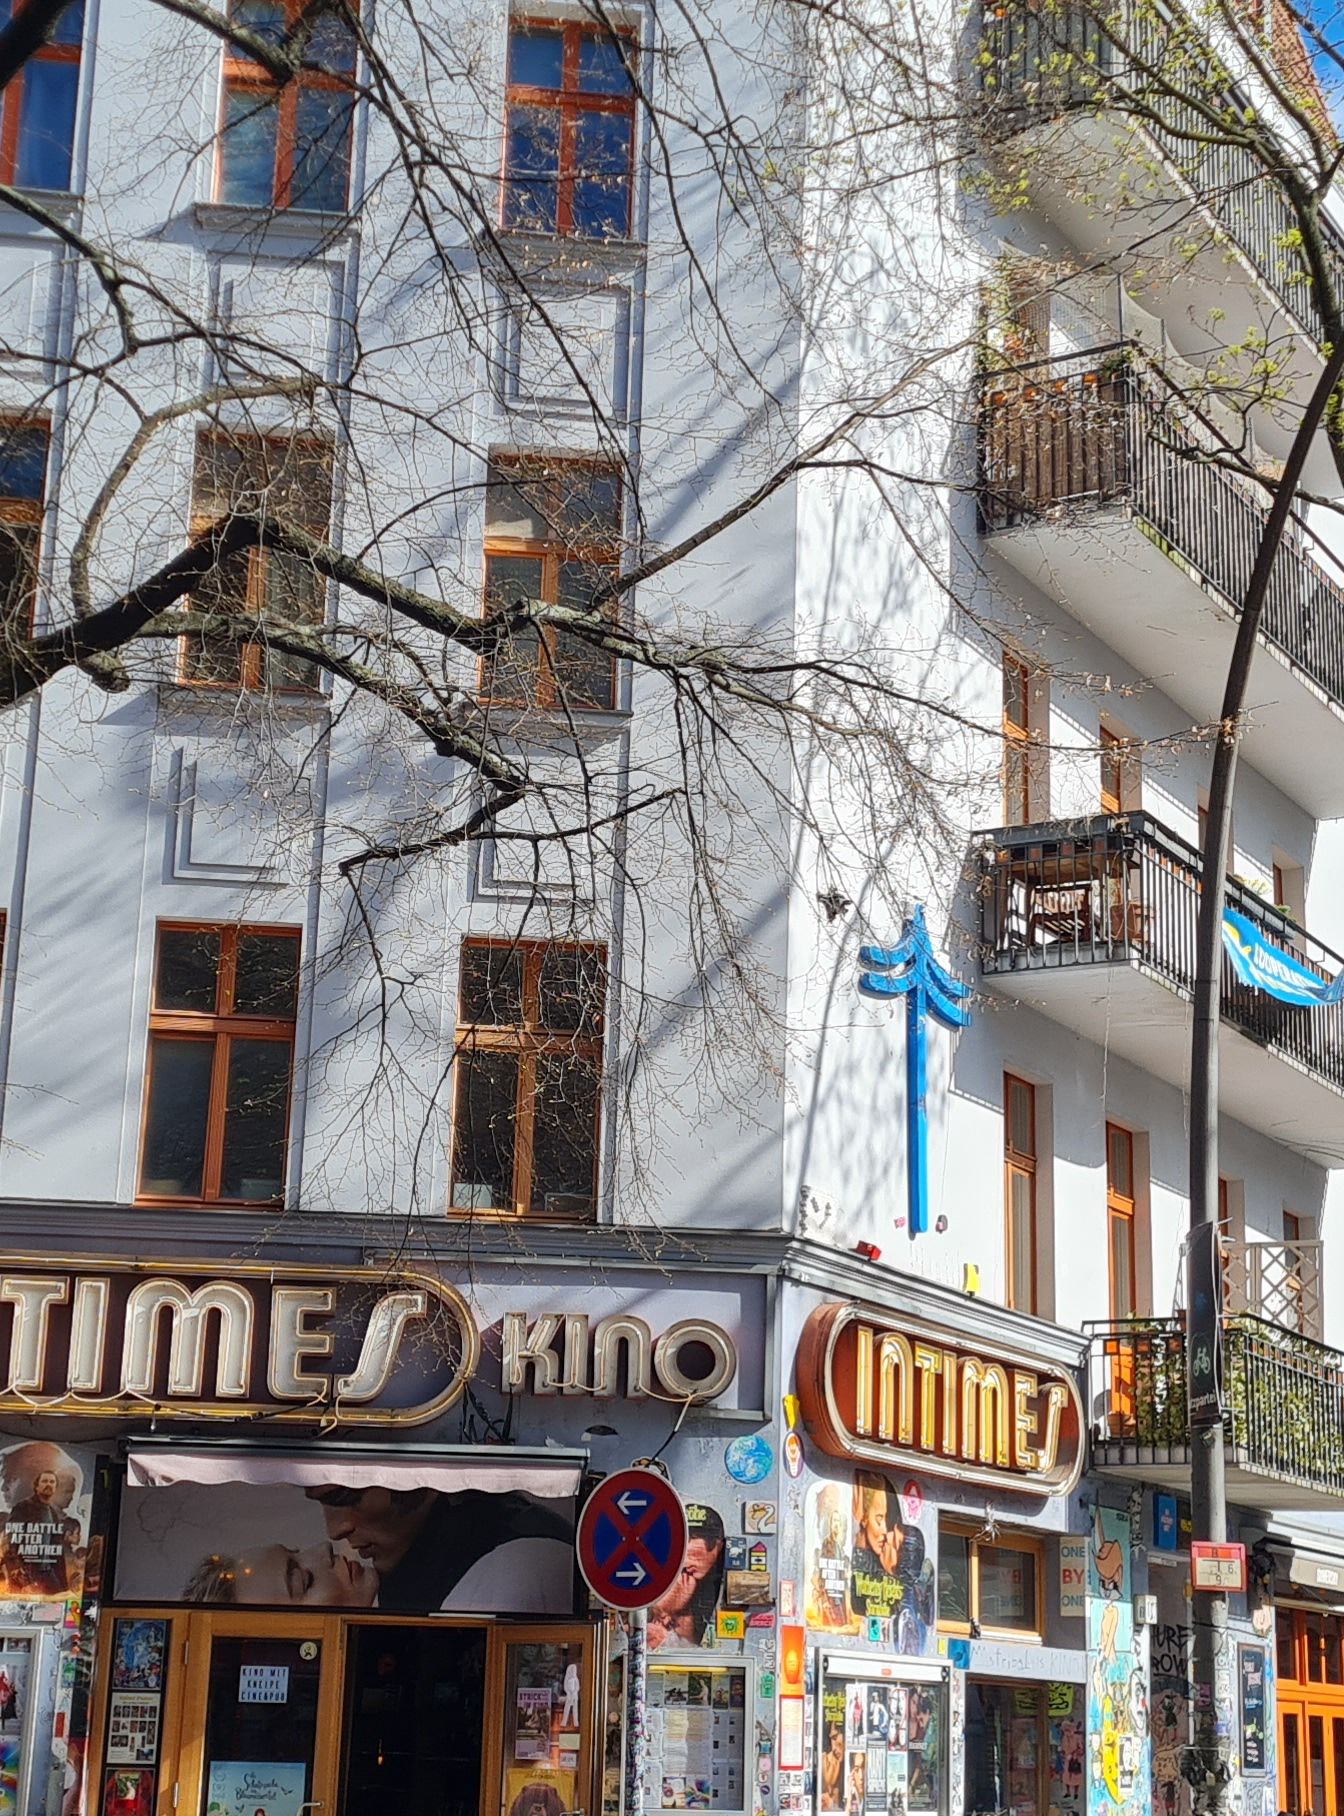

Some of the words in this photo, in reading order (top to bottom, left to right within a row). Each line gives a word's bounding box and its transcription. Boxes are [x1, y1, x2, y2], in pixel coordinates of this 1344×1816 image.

[502, 1312, 738, 1405] KINO
[855, 1325, 1069, 1474] INTIMES
[5, 1522, 24, 1534] ONE
[26, 1522, 64, 1534] BATTLE
[11, 1533, 43, 1545] AFTER
[17, 1544, 63, 1556] ANOTHER
[1060, 1546, 1086, 1558] ONE
[1062, 1568, 1085, 1585] BY
[1060, 1594, 1086, 1607] ONE
[242, 1668, 264, 1677] KINO
[270, 1668, 286, 1678] MIT
[247, 1680, 280, 1690] KNEIPE
